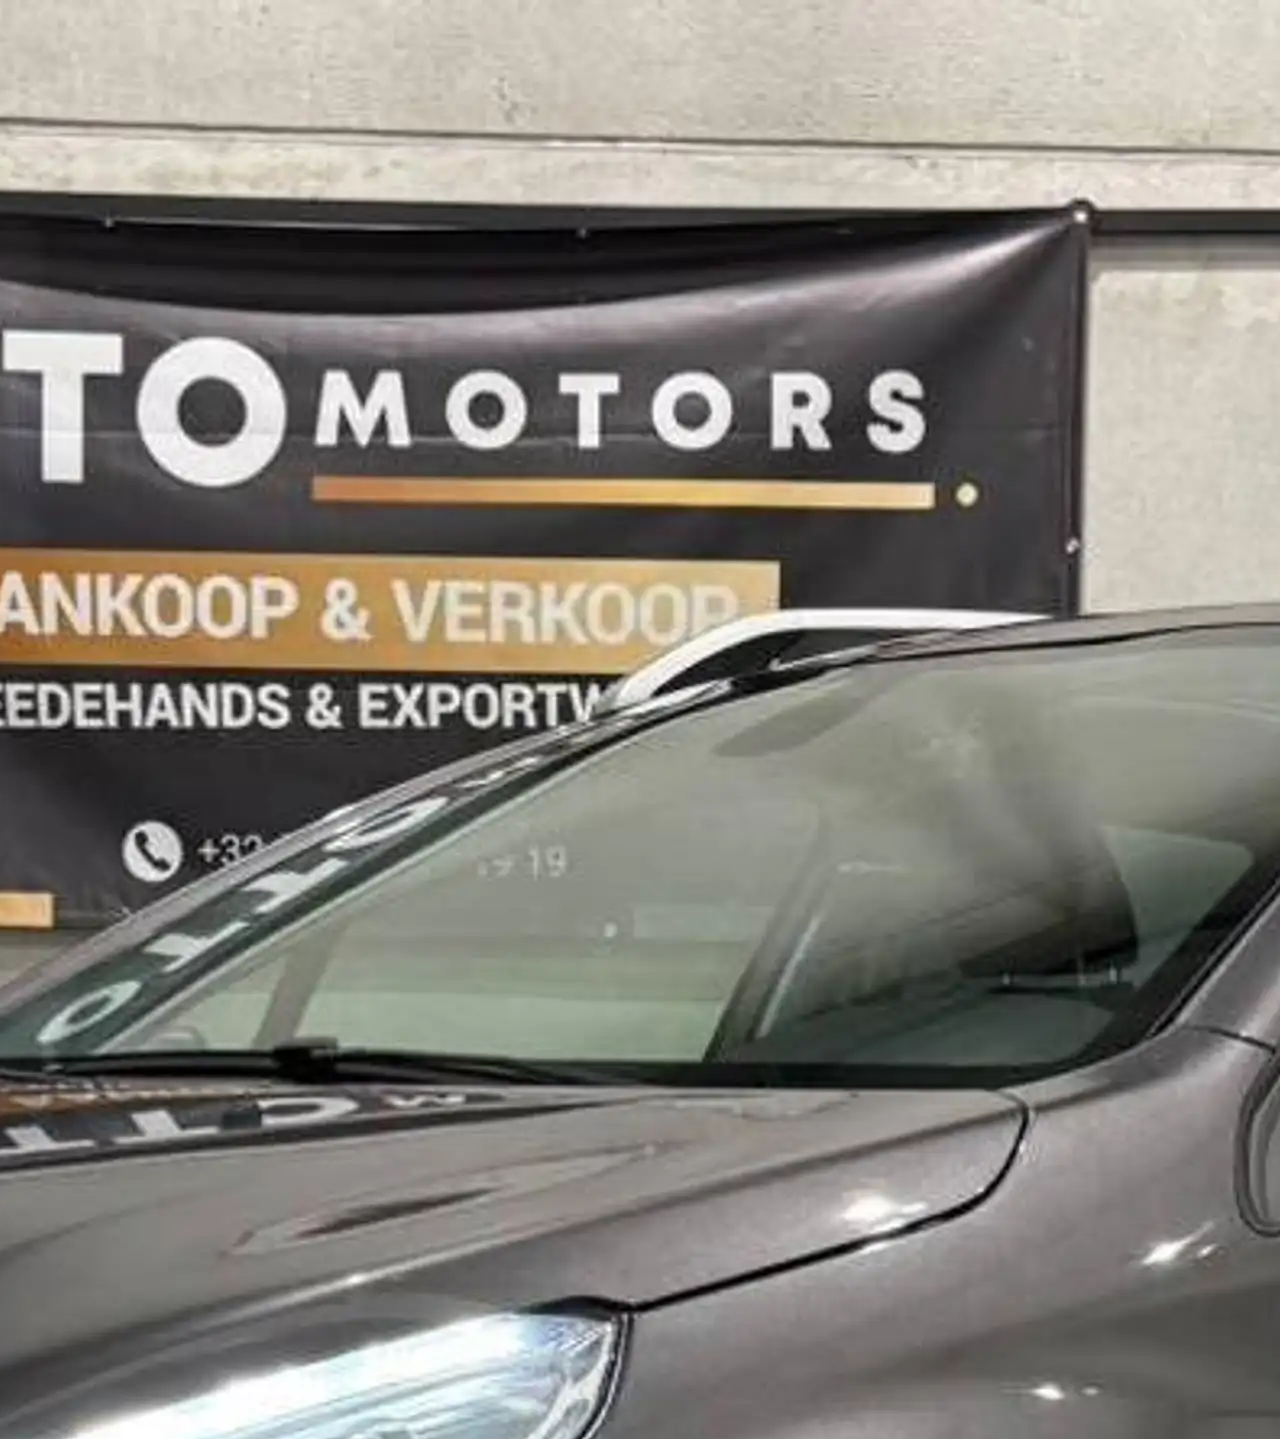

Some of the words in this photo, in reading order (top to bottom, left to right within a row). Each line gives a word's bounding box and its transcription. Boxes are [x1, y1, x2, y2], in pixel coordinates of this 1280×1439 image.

[313, 369, 928, 455] MOTORS
[321, 577, 374, 642] &
[392, 580, 740, 646] VERKOOP
[306, 684, 346, 730] &
